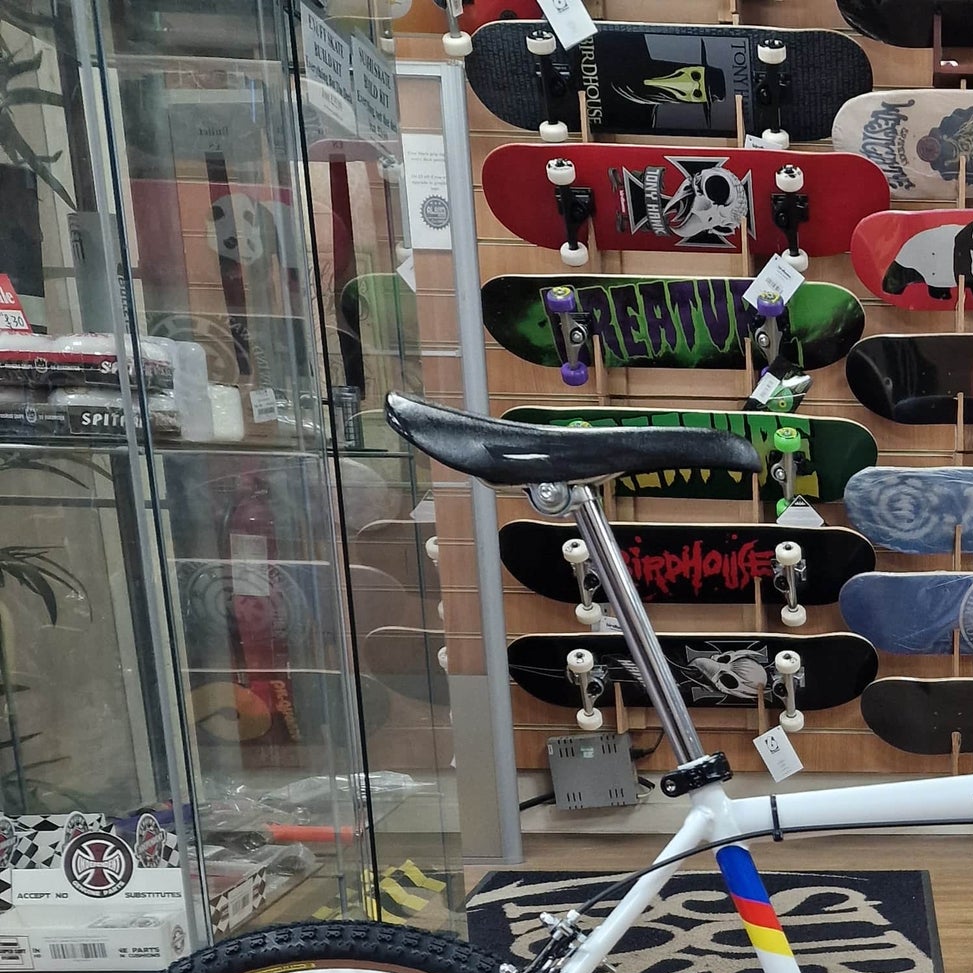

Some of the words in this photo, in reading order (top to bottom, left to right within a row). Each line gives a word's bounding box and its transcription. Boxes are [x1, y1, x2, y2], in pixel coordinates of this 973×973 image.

[730, 40, 749, 86] TONY
[644, 169, 660, 200] TONY
[125, 891, 182, 899] SUBSTITUTES
